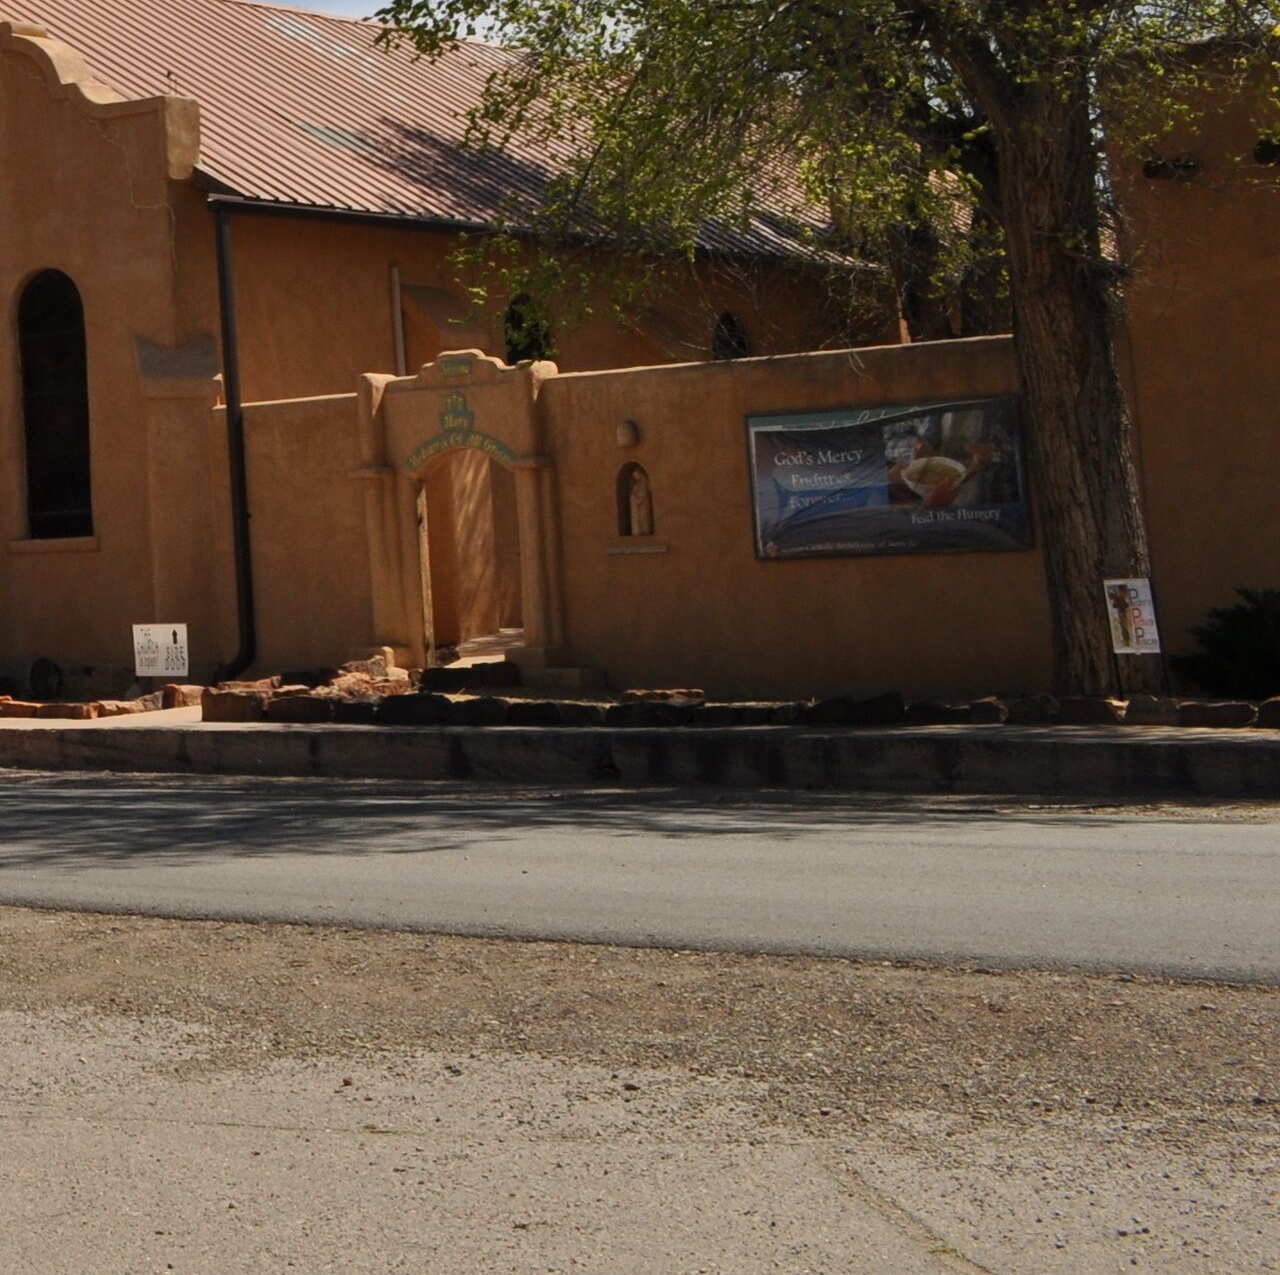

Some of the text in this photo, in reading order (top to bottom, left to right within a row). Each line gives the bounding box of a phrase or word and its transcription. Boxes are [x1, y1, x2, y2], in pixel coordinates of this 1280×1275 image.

[774, 449, 863, 467] God's Mercy
[791, 472, 851, 488] Endures
[911, 507, 1001, 524] Feed the Hungry
